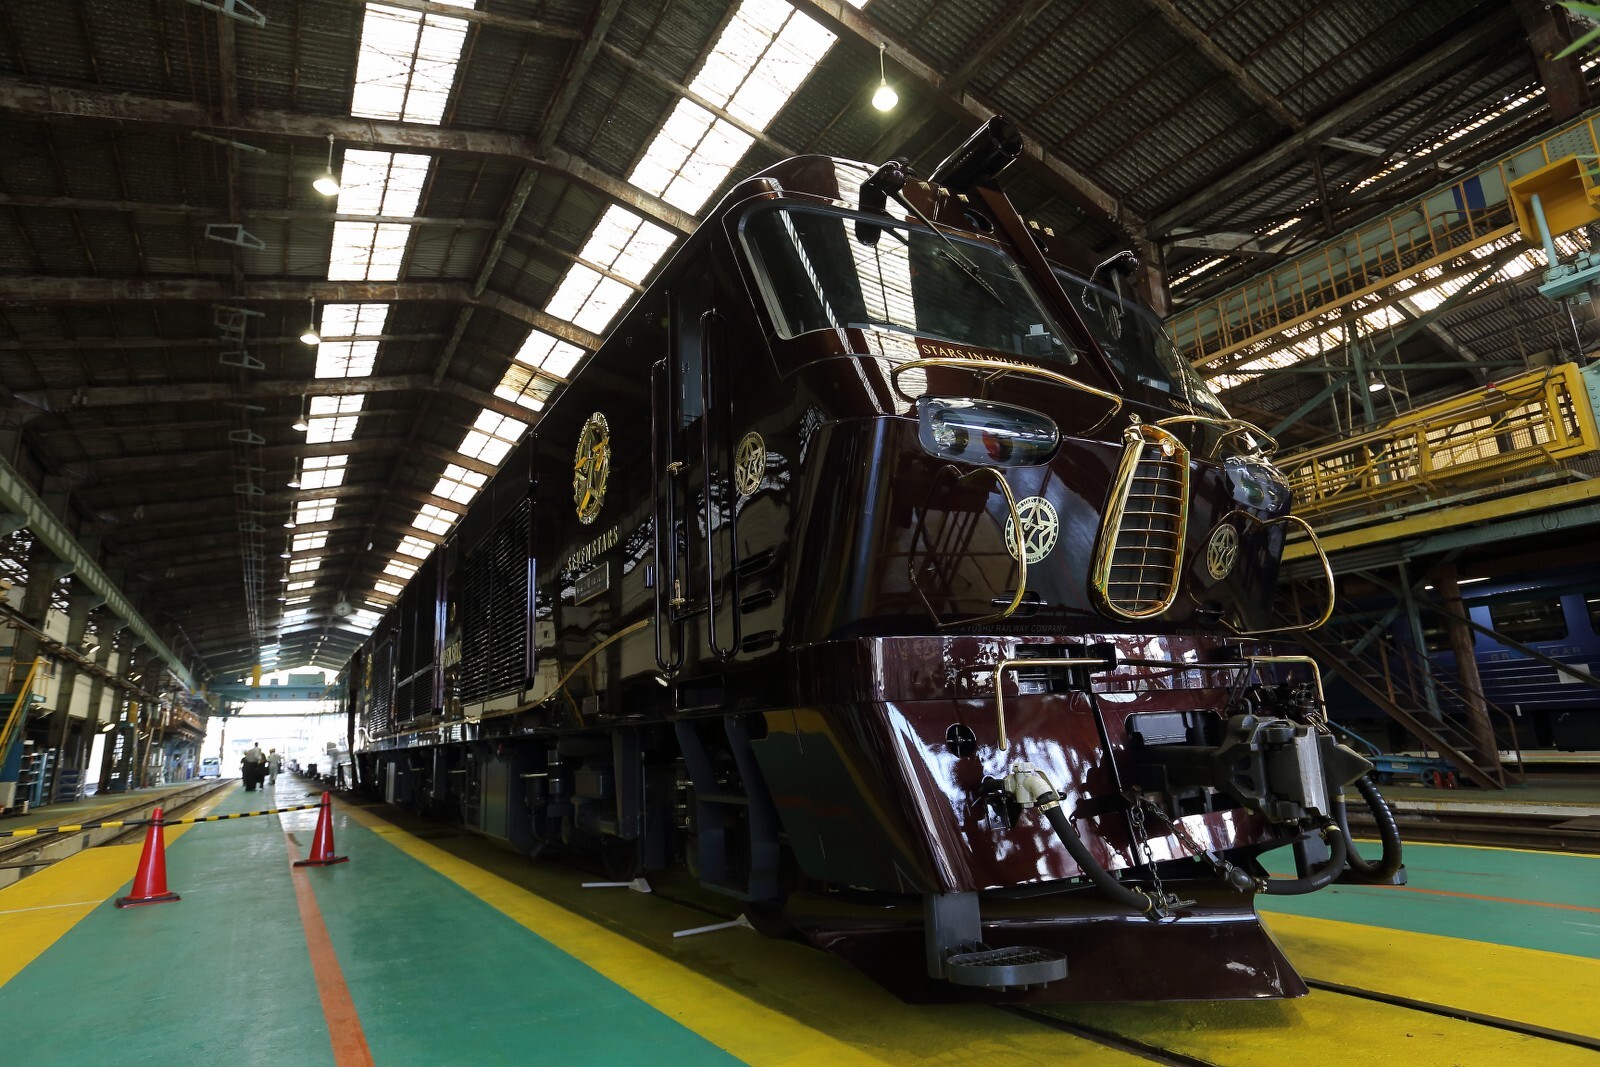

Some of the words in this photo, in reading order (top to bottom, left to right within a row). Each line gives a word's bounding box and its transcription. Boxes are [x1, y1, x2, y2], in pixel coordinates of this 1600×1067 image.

[921, 344, 966, 359] STARS
[592, 525, 619, 559] STARS
[960, 624, 993, 633] KYUSHU
[995, 624, 1029, 633] RAILWAY
[1030, 624, 1067, 633] COMPANY
[1550, 646, 1581, 657] CAR
